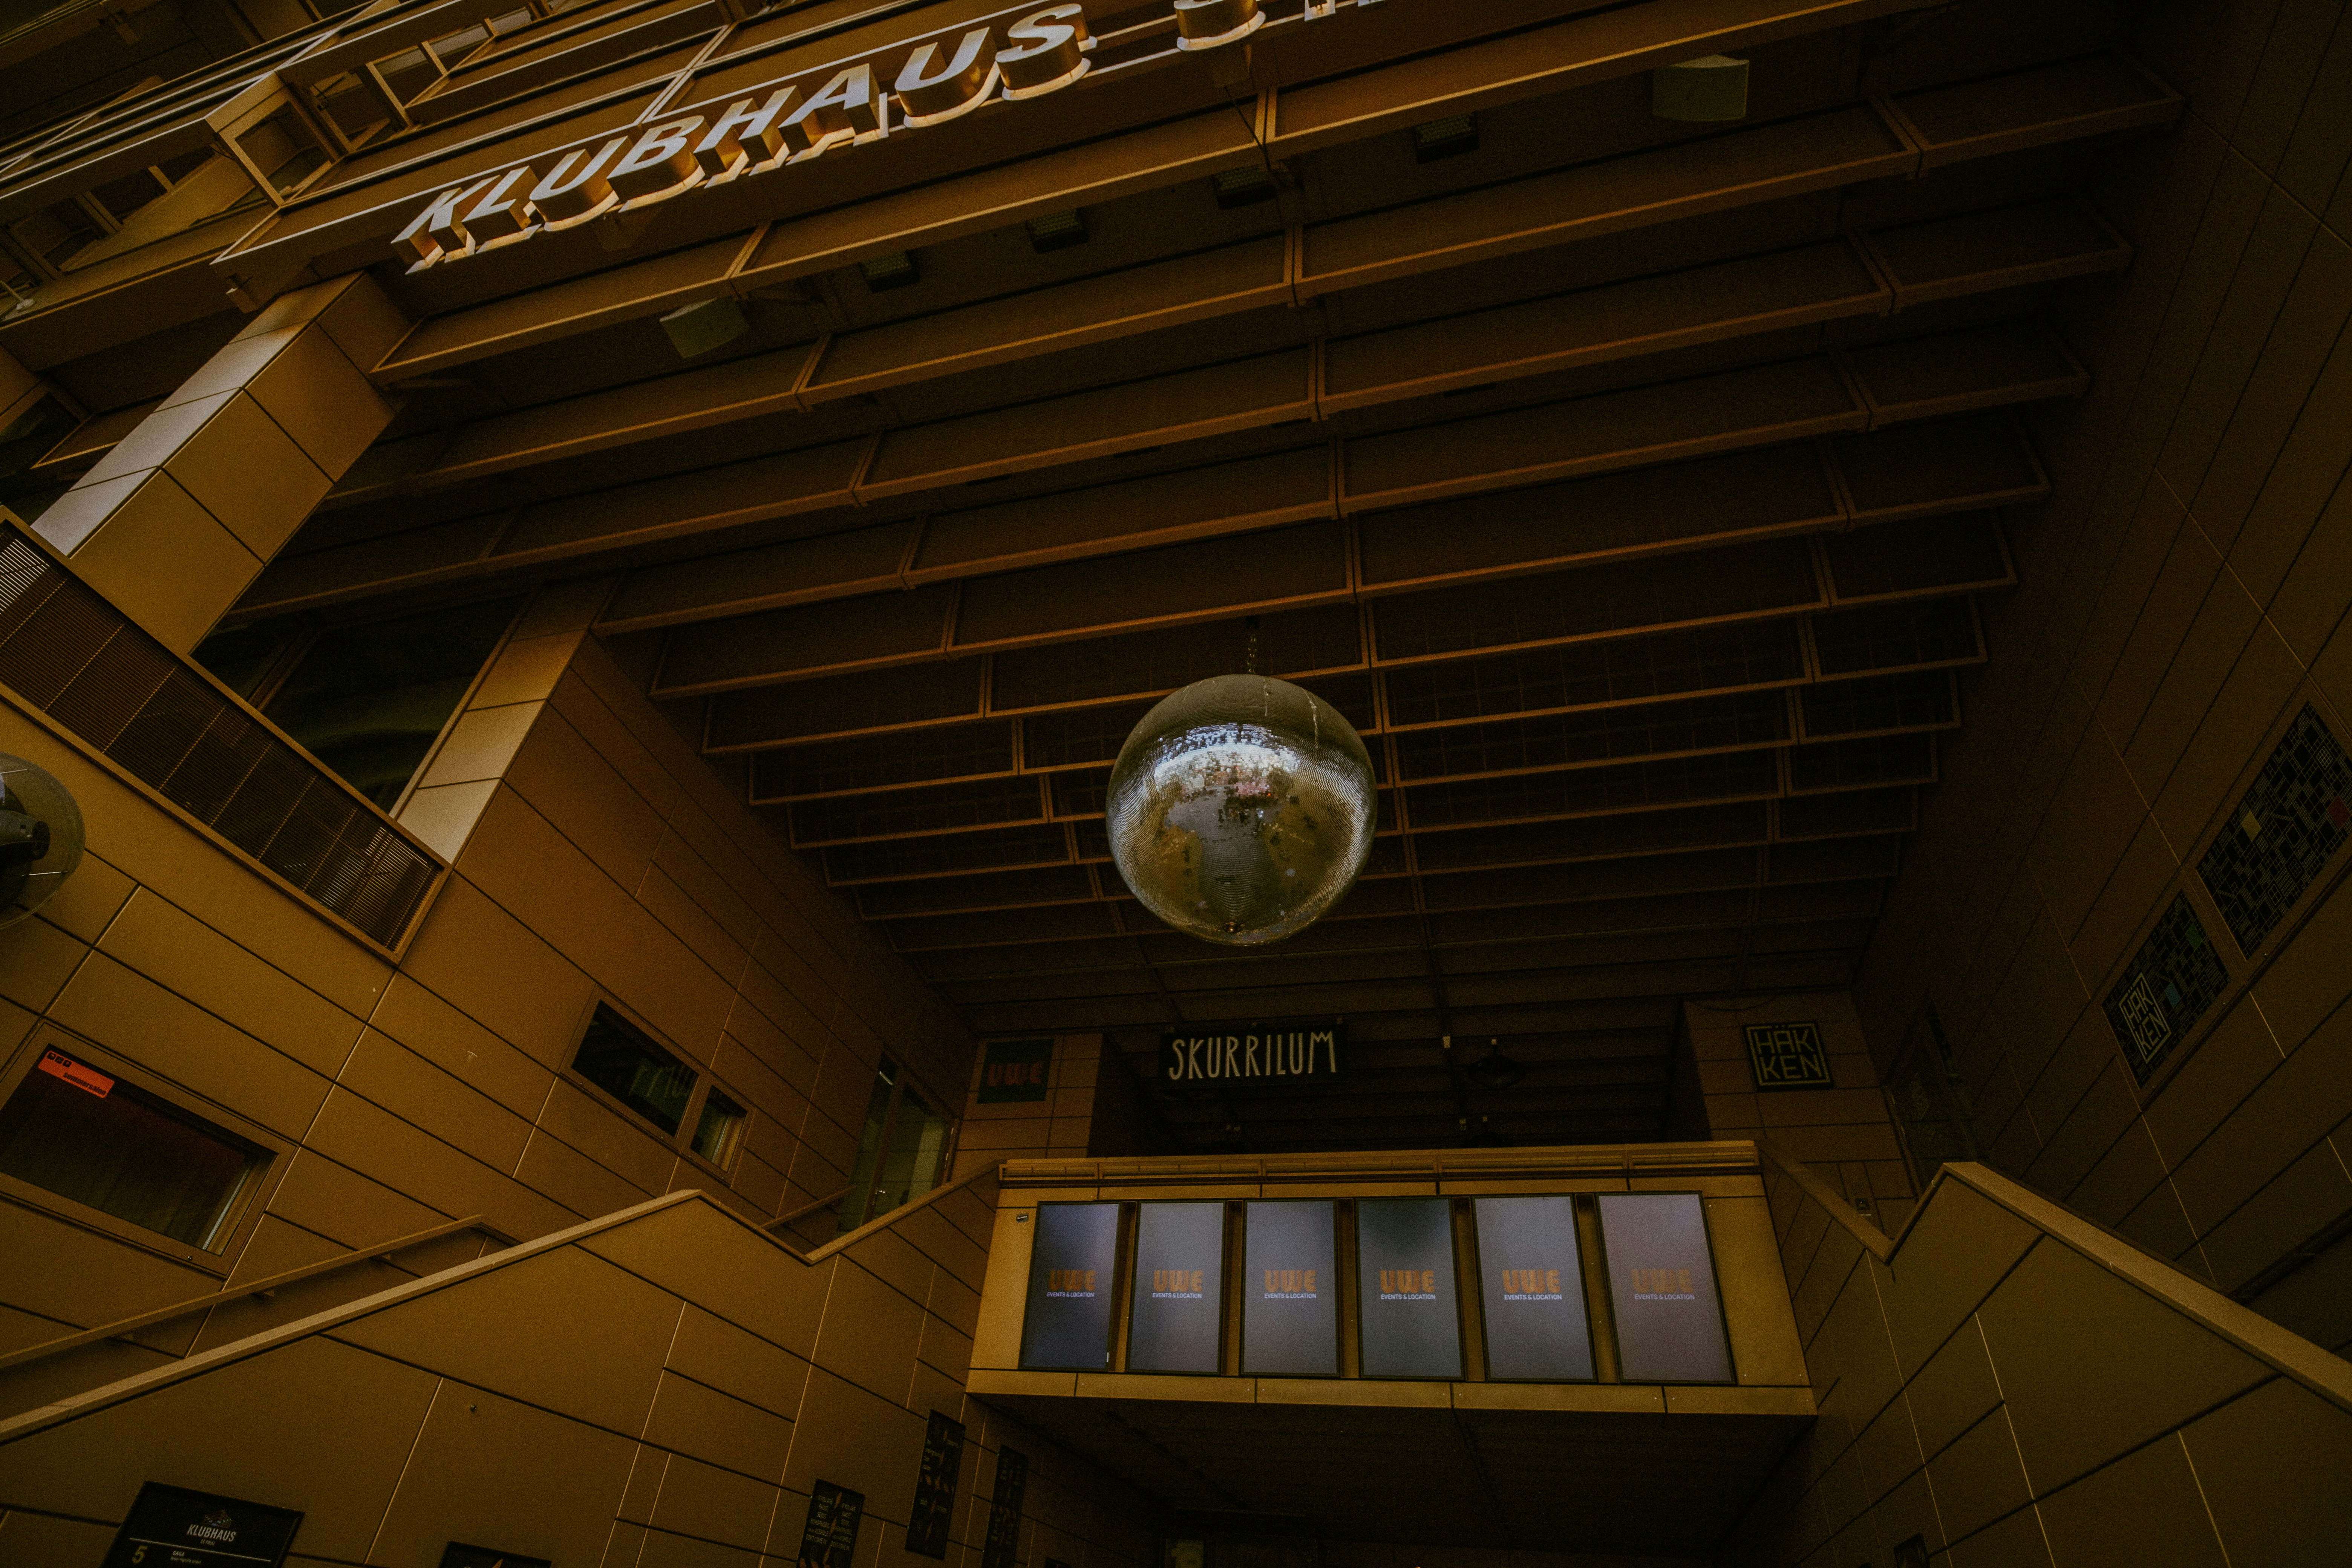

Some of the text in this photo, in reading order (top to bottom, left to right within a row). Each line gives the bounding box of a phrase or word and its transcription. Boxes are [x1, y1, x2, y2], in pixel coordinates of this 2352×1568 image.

[388, 3, 1095, 268] KLUBHAUS
[2135, 1006, 2167, 1055] KEN
[1168, 1030, 1337, 1081] SKURRILUM
[1760, 1053, 1824, 1081] KEN
[986, 1062, 1043, 1087] UWE
[1049, 1269, 1096, 1292] UWE
[1154, 1269, 1203, 1292] UWE
[1265, 1269, 1316, 1293] UWE
[1380, 1269, 1435, 1294] UWE
[1503, 1269, 1561, 1294] UWE
[1632, 1269, 1693, 1293] UWE
[187, 1524, 237, 1543] KLUBHAUS
[132, 1545, 148, 1564] 5
